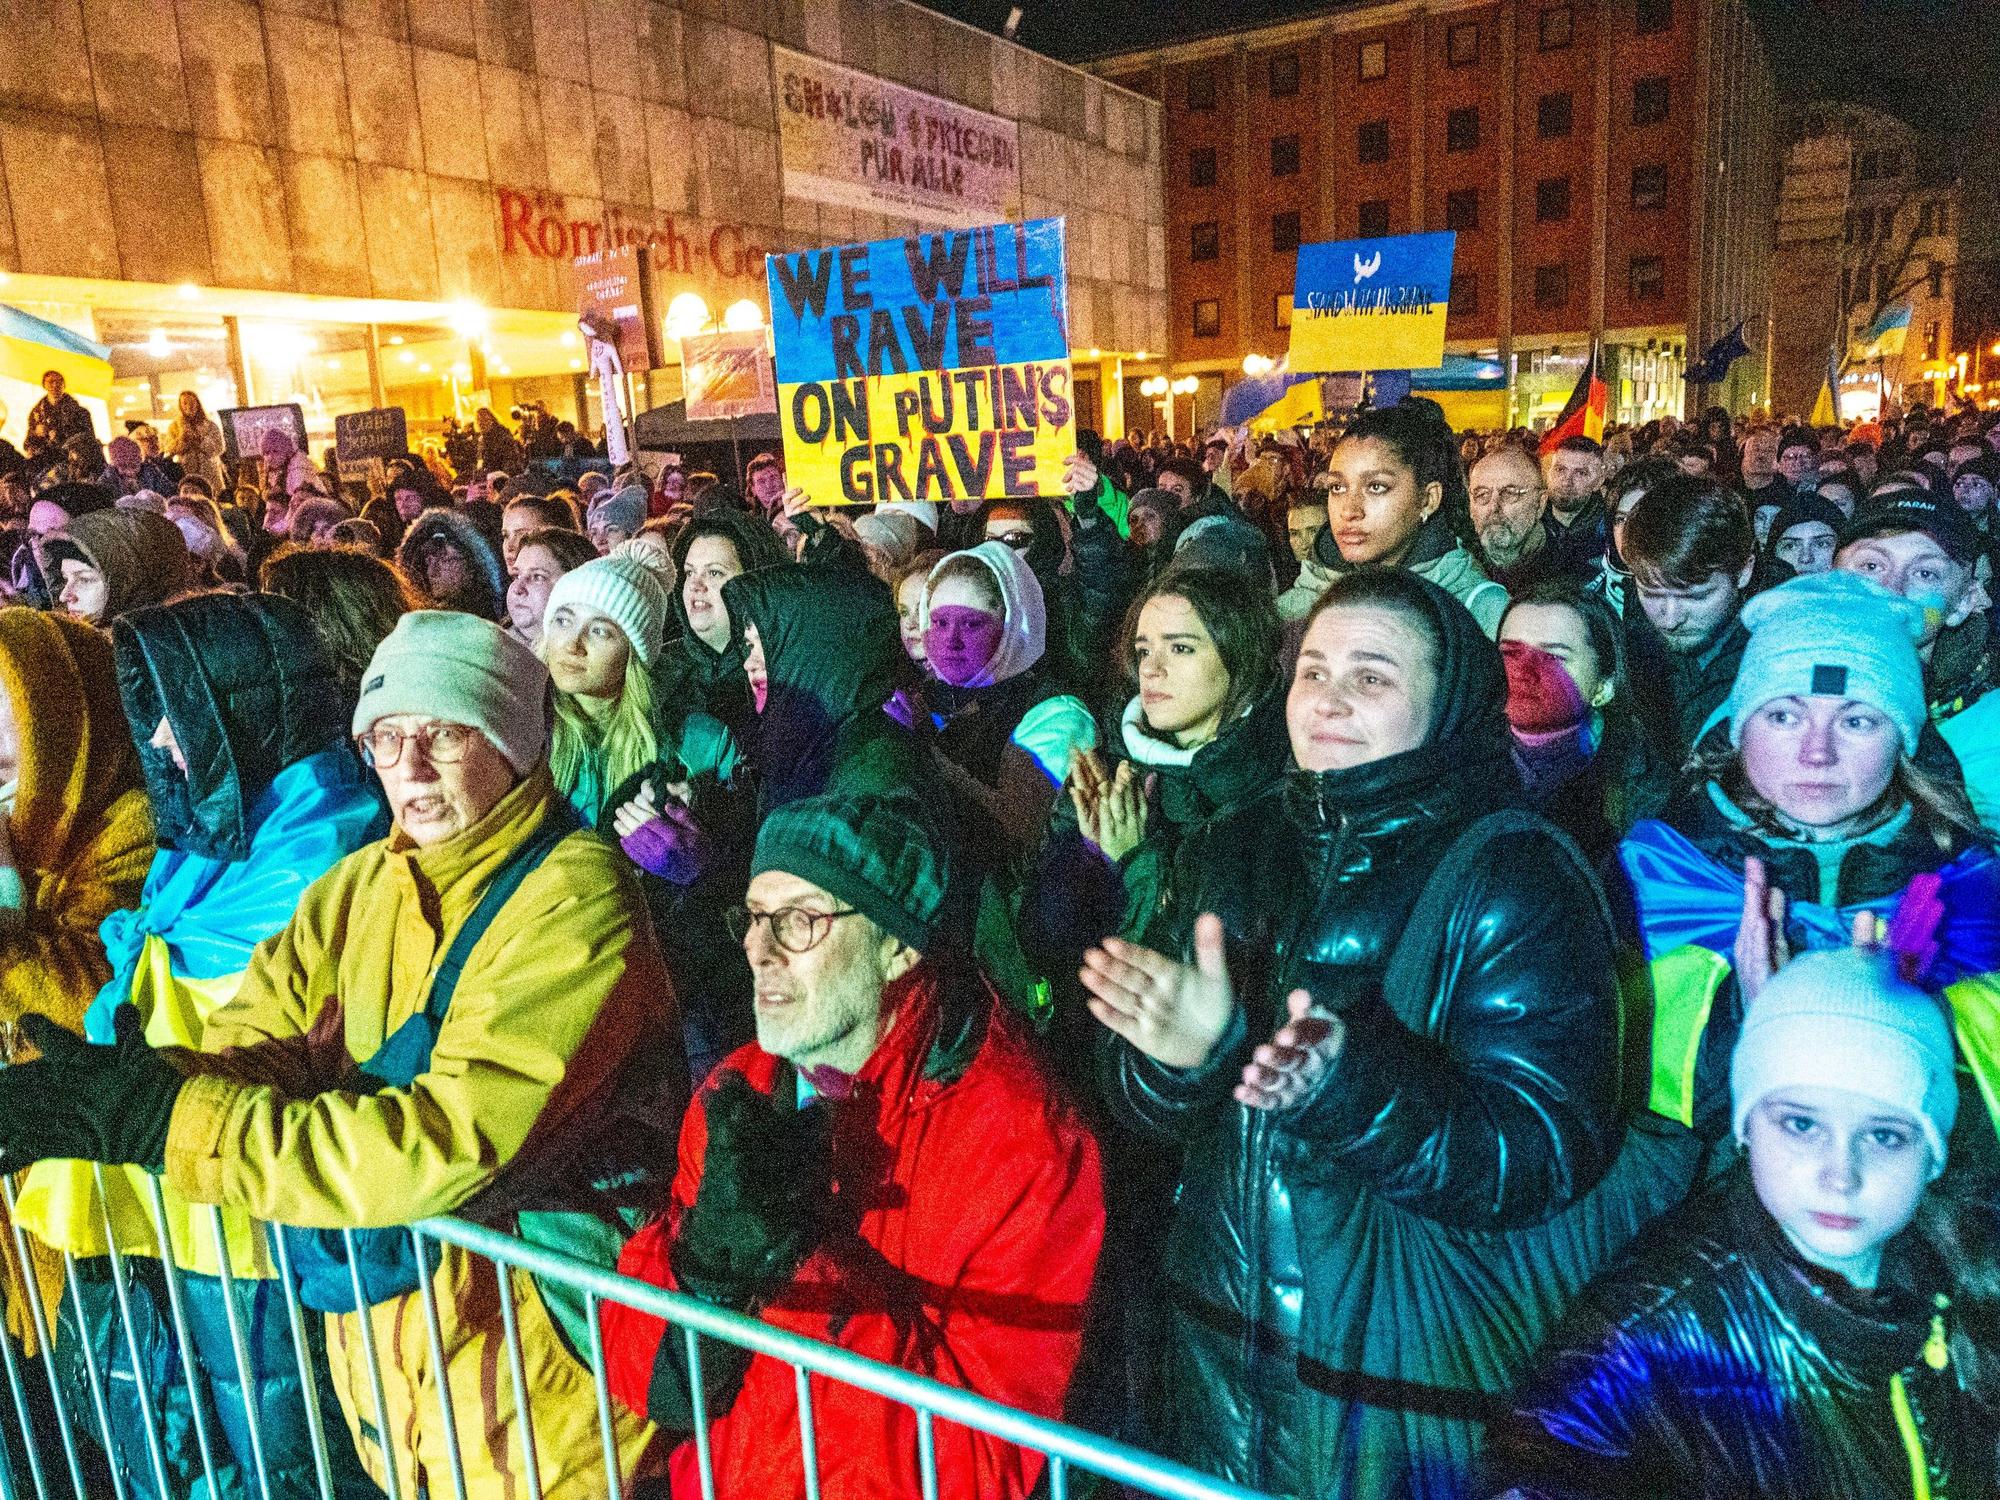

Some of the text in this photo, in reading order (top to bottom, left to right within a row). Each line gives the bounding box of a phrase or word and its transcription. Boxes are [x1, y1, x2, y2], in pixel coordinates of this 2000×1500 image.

[497, 185, 767, 281] Römisch-Ge
[774, 222, 1055, 318] WE WILL
[831, 296, 994, 381] RAVE
[792, 364, 1070, 444] ON PUTIN'S
[840, 430, 1039, 503] GRAVE
[1897, 500, 1936, 511] FARAH
